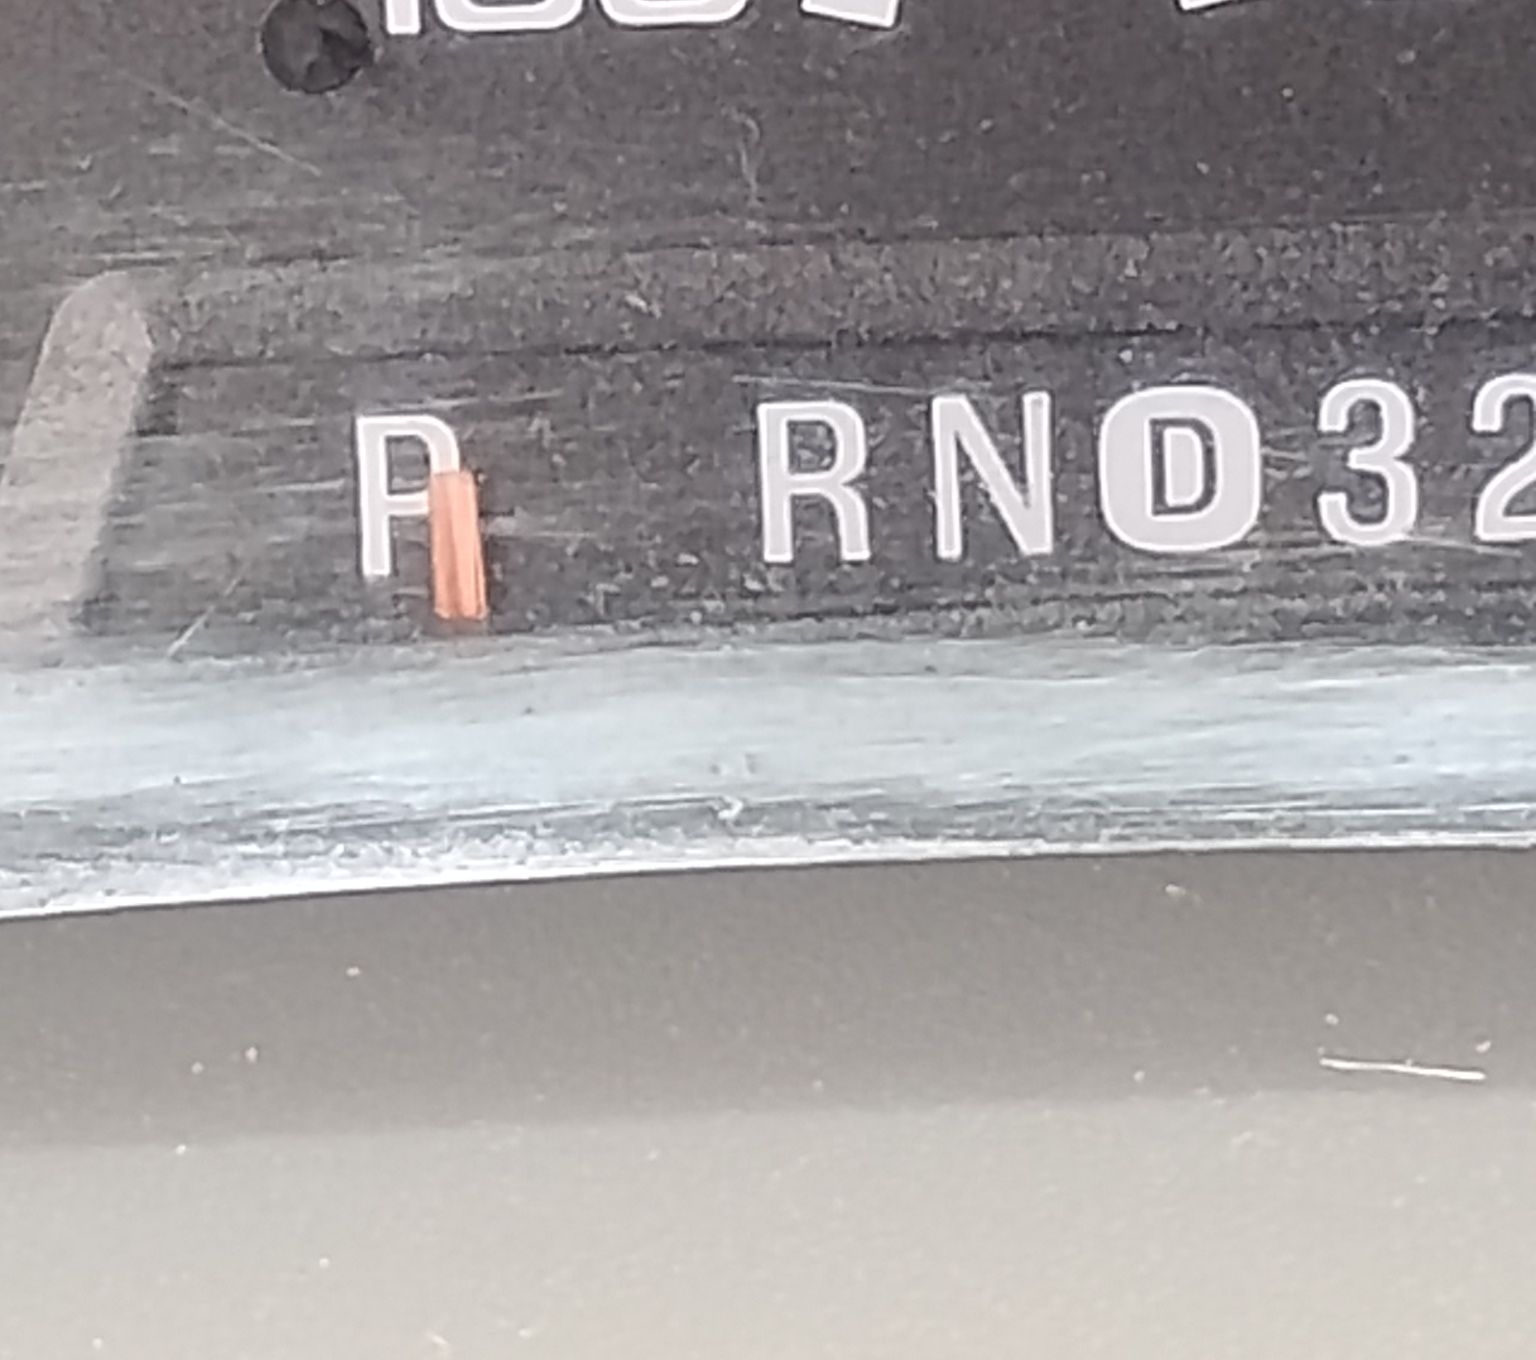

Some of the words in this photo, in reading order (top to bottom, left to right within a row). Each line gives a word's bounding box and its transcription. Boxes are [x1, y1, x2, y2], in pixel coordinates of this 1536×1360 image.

[755, 396, 872, 564] R
[928, 389, 1056, 560] N
[1098, 383, 1264, 554] D
[1316, 377, 1421, 548] 3
